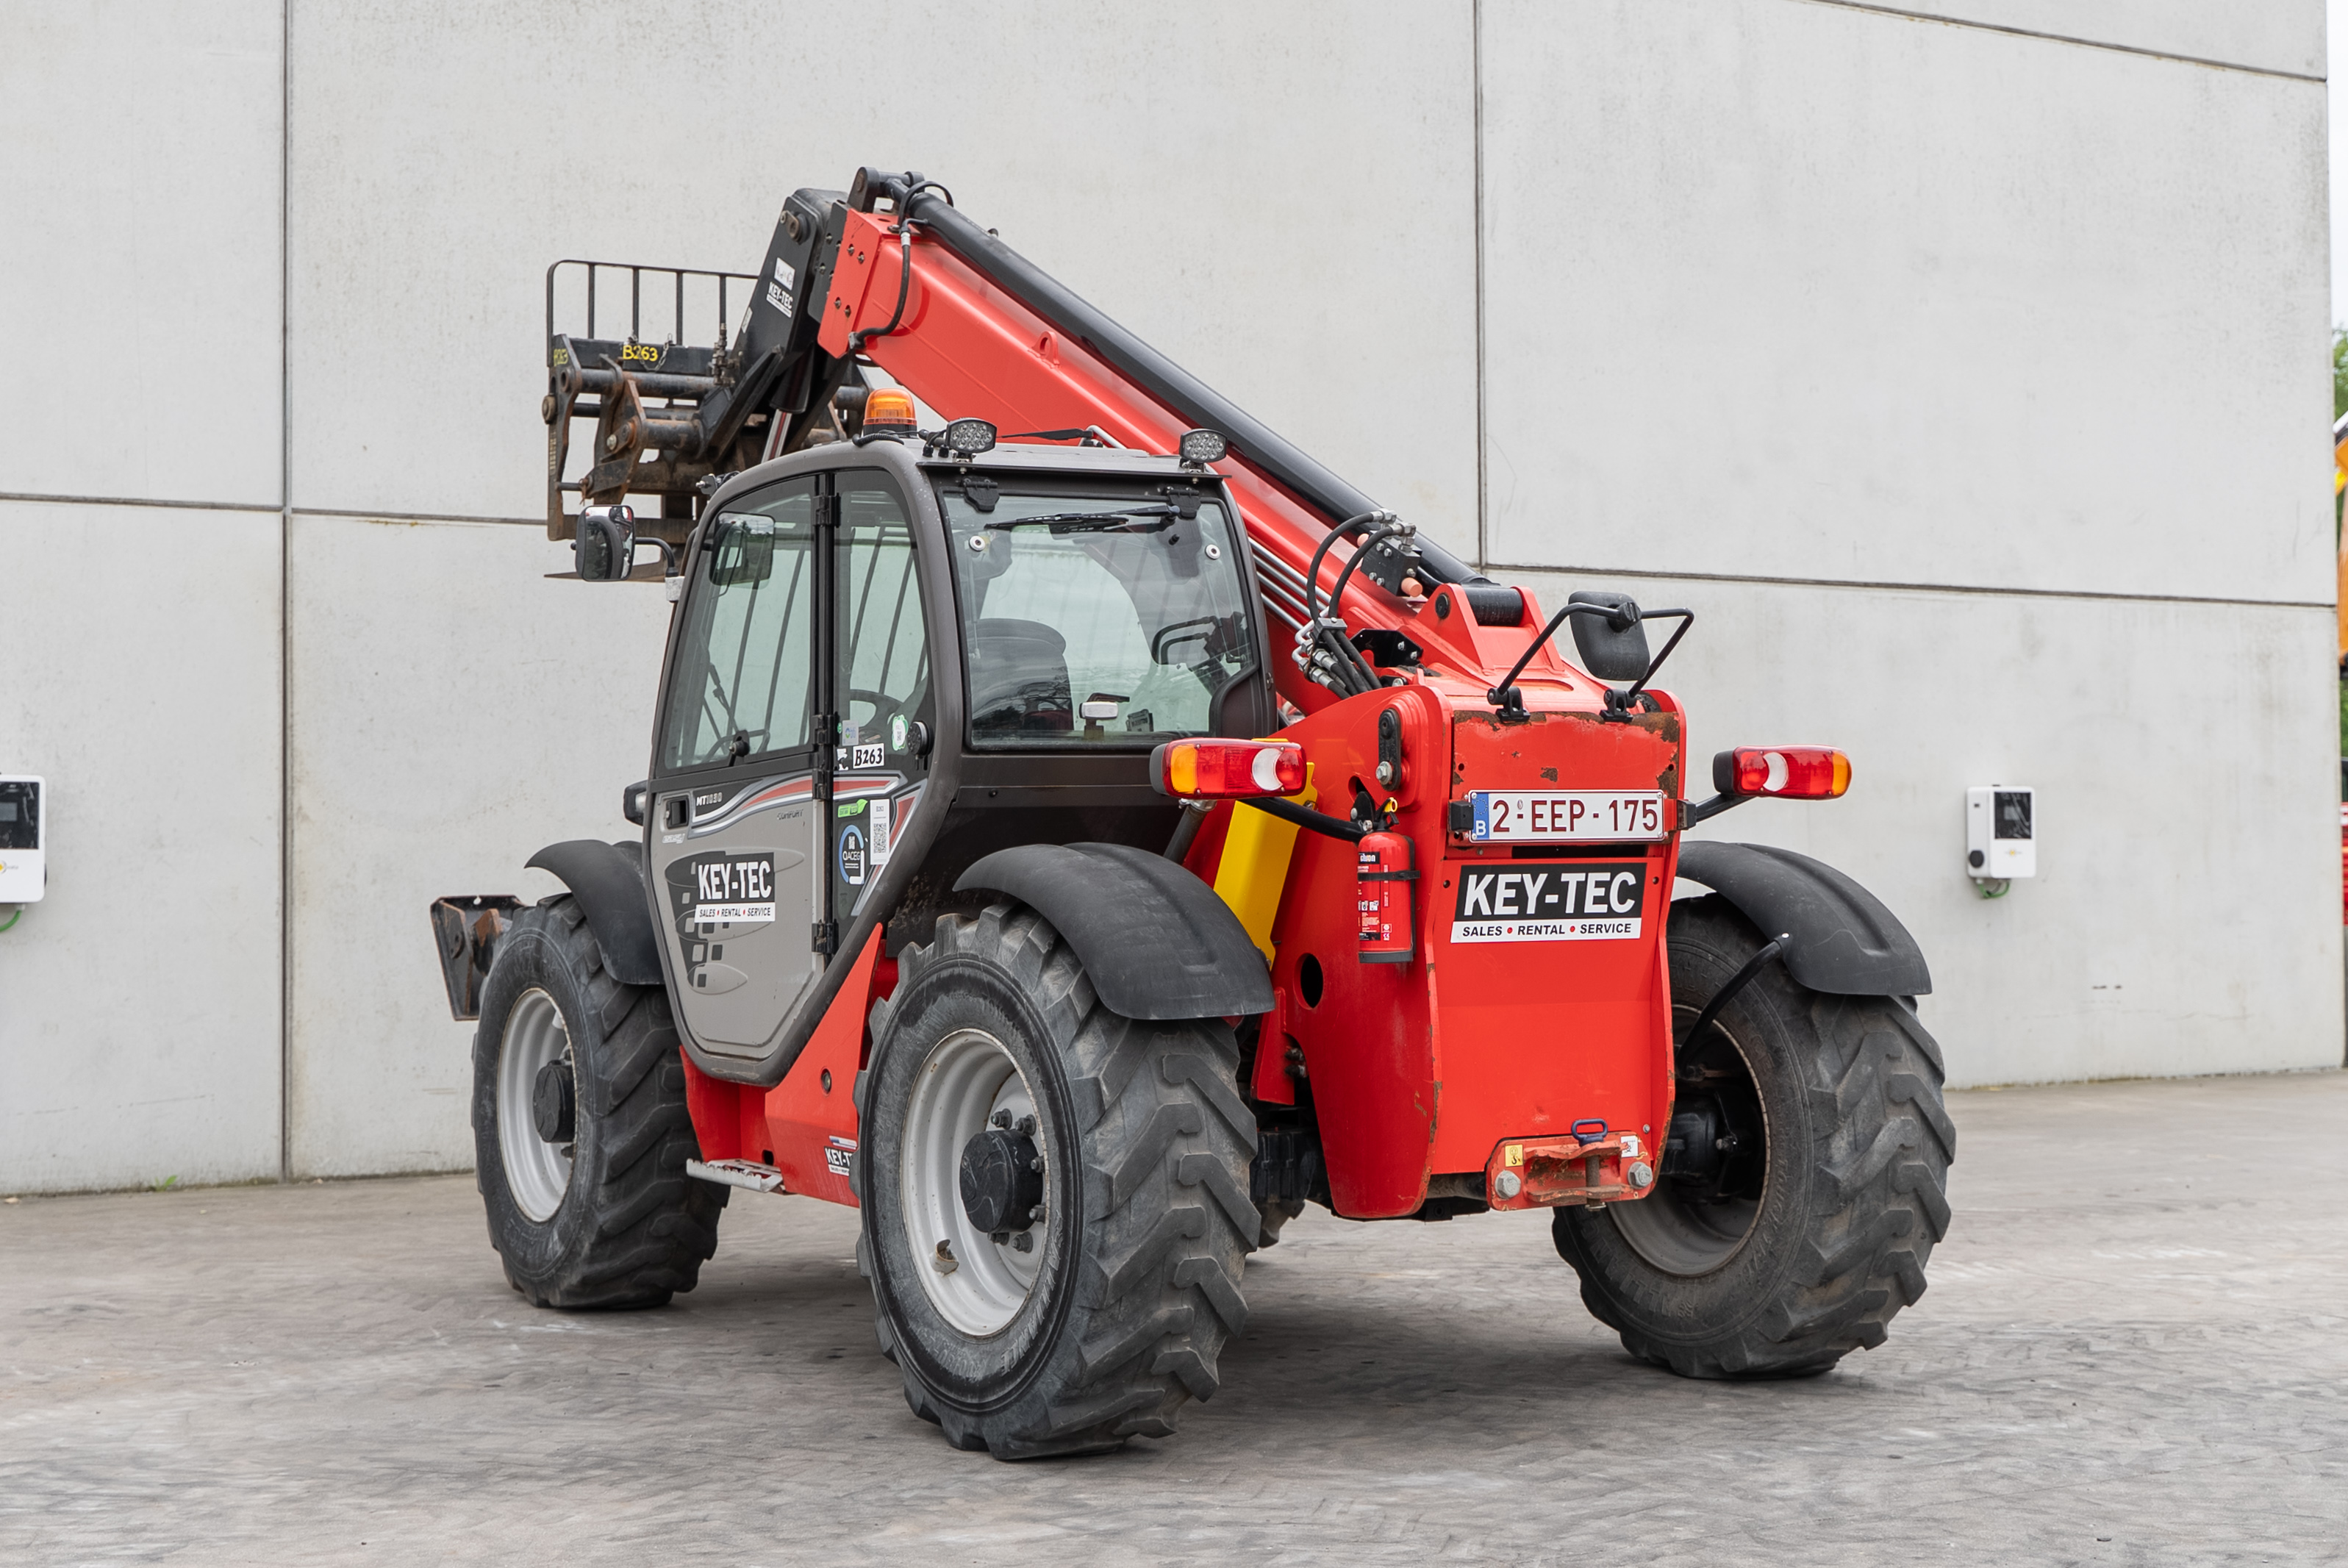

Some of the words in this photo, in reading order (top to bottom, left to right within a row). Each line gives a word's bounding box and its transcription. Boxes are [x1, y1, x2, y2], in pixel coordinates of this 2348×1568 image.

[768, 282, 793, 309] KEY-TEC
[623, 345, 658, 362] B263
[854, 748, 883, 767] B263
[1475, 820, 1486, 836] B
[698, 860, 772, 900] KEY-TEC
[1464, 871, 1636, 916] KEY-TEC
[699, 909, 715, 917] SALES
[720, 908, 741, 917] RENTAL
[747, 907, 770, 917] SERVICE
[1462, 926, 1503, 937] SALES
[1517, 925, 1565, 936] RENTAL
[1580, 923, 1631, 934] SERVICE
[825, 1148, 852, 1167] KEY-T
